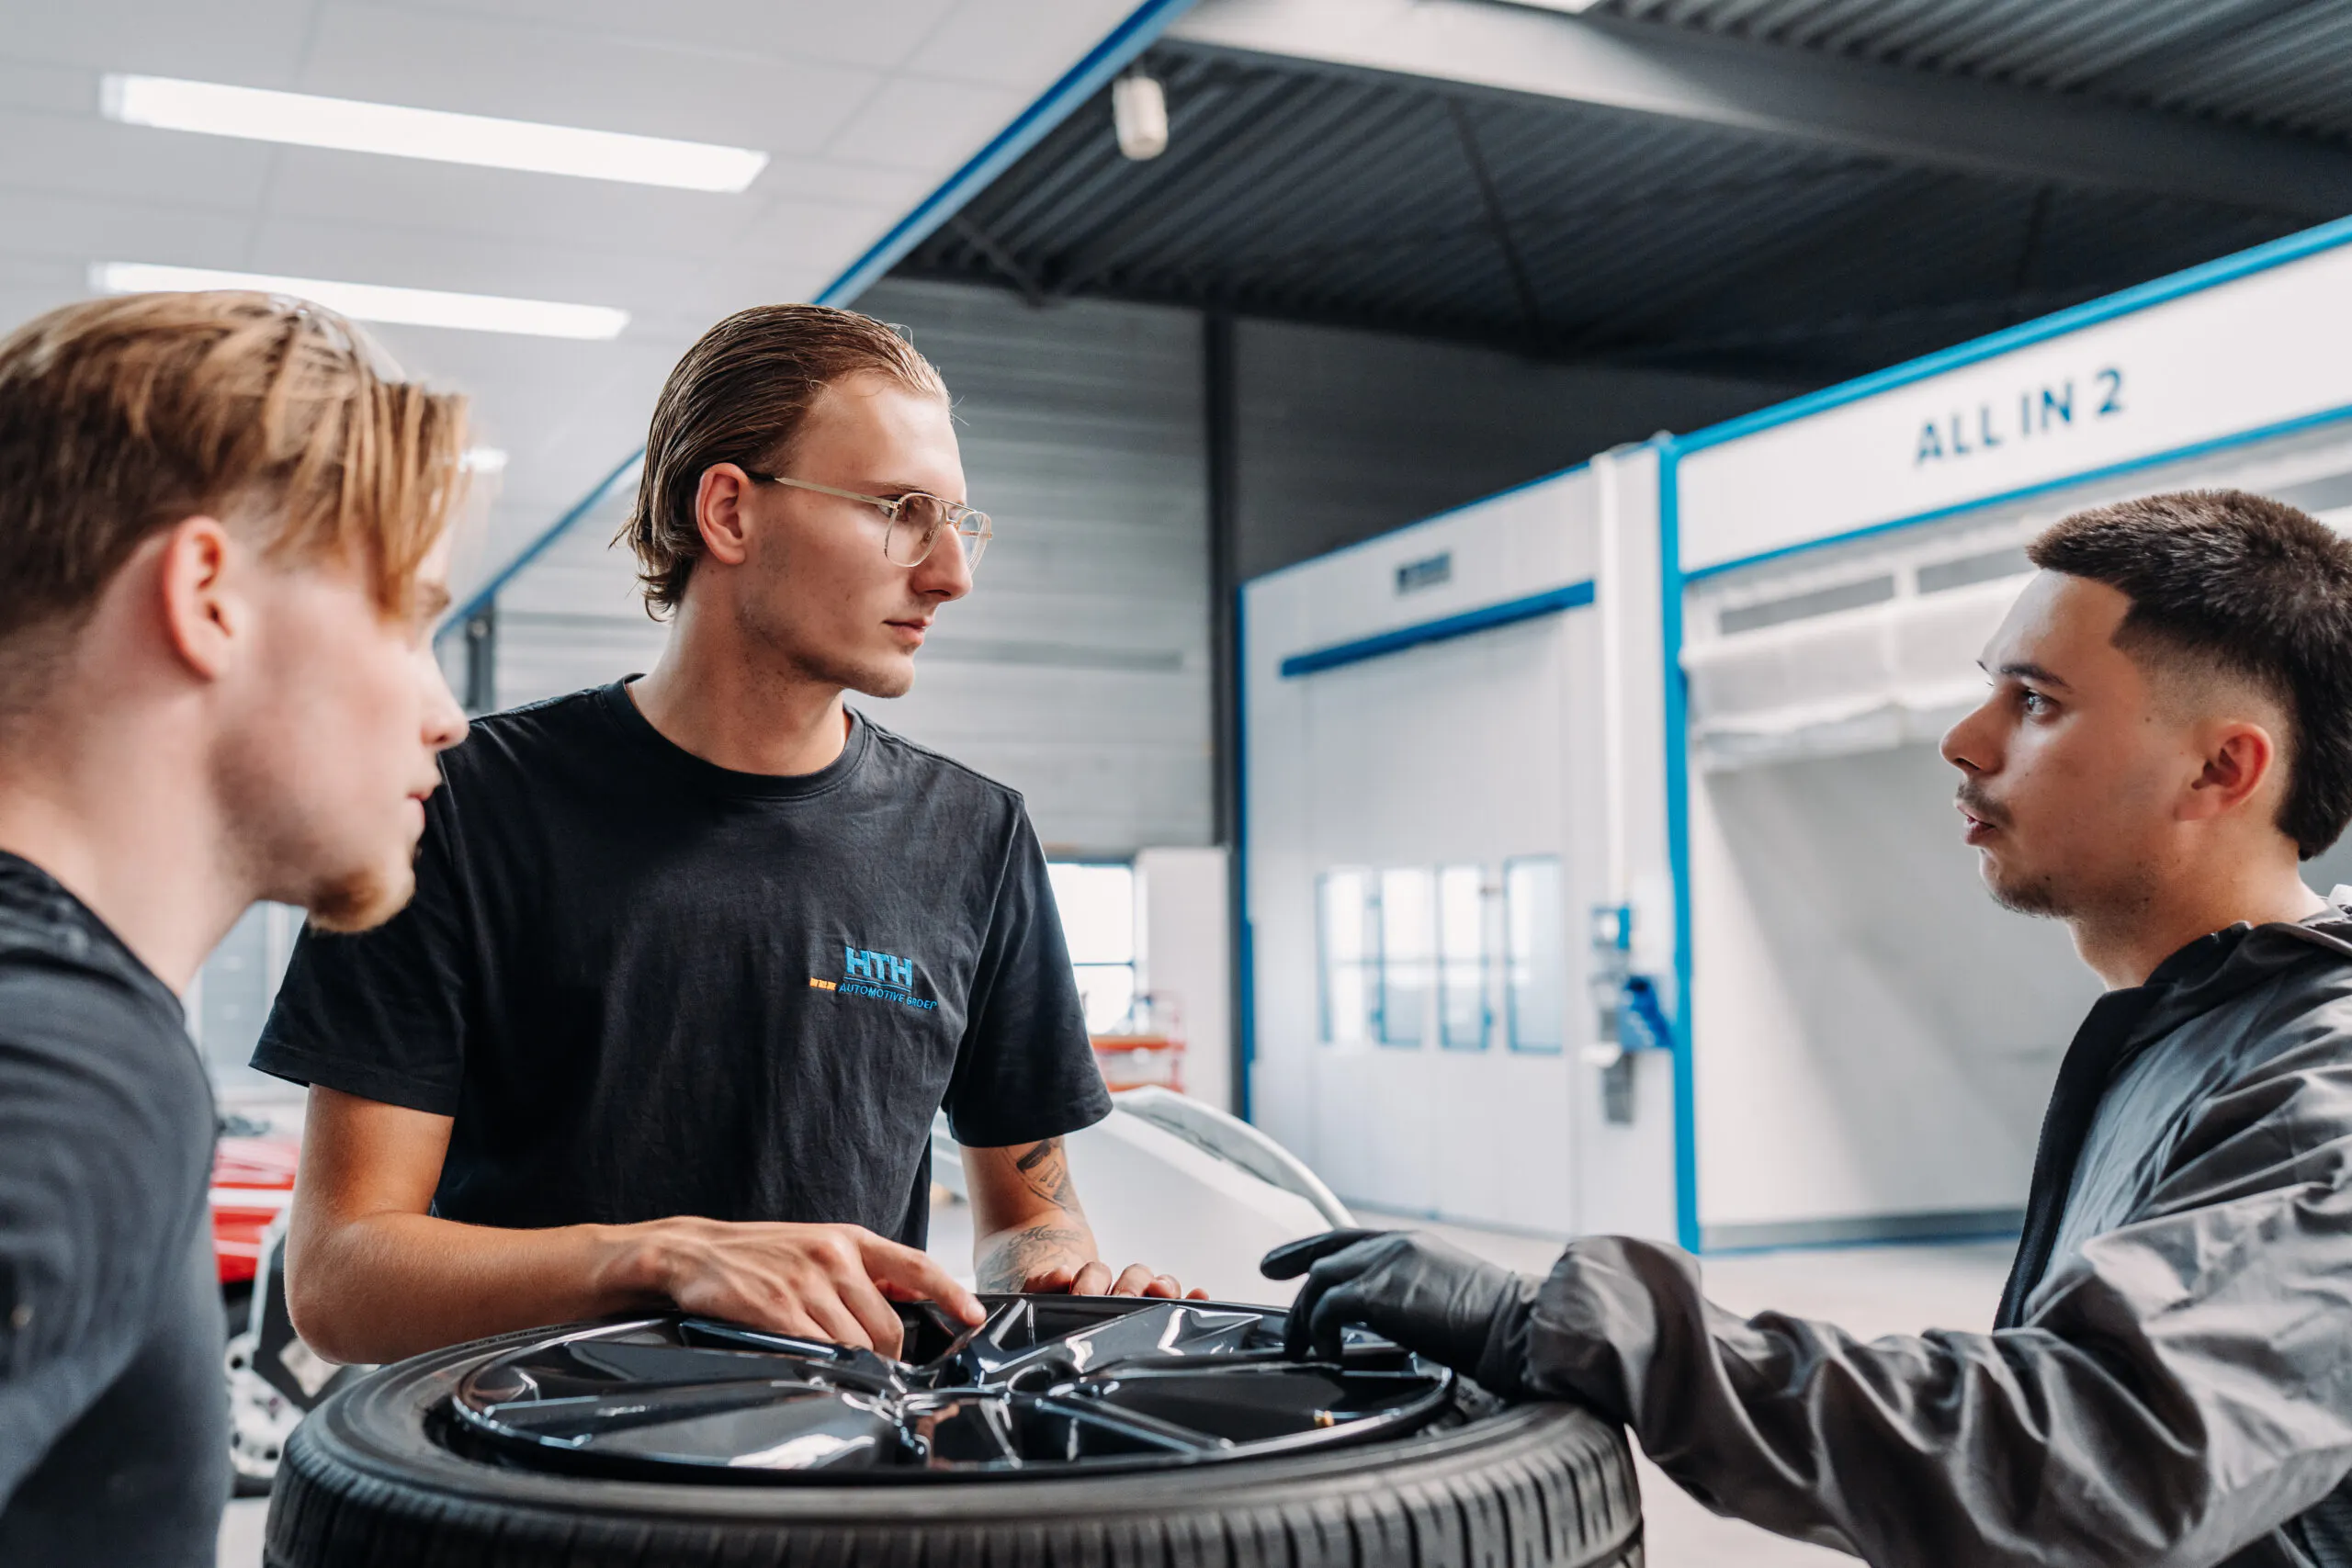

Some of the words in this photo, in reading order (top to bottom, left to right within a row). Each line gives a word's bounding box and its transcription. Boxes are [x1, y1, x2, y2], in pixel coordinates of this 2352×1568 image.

[1917, 406, 2004, 463] ALL
[2021, 379, 2074, 435] IN
[2096, 367, 2124, 415] 2
[844, 945, 913, 987] HTH
[838, 982, 906, 1004] AUTOMOTIVE
[906, 996, 938, 1010] GROEP
